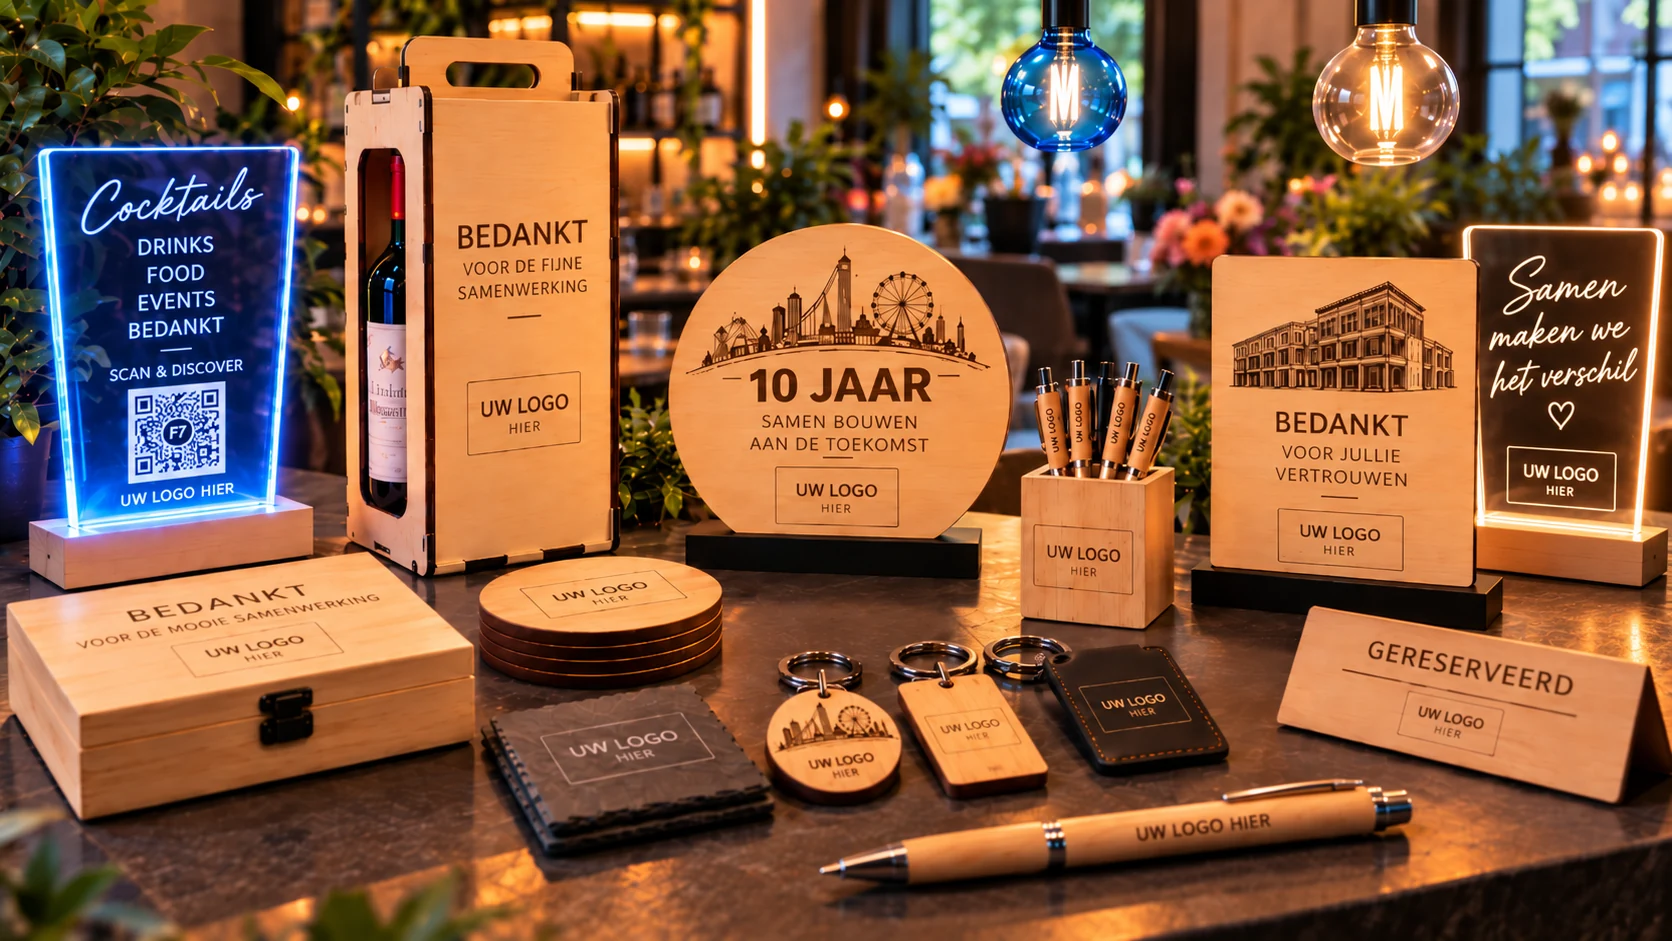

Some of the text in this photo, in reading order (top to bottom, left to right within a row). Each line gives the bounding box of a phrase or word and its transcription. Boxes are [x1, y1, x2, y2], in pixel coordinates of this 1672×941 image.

[80, 167, 264, 235] Cocktails
[457, 220, 588, 249] BEDANKT
[138, 235, 214, 256] DRINKS
[147, 264, 205, 284] FOOD
[463, 256, 582, 276] VOOR DE FIJNE
[458, 279, 588, 300] SAMENWERKING
[1502, 255, 1627, 316] Samen
[138, 290, 216, 312] EVENTS
[128, 316, 224, 340] BEDANKT
[1489, 311, 1631, 351] maken we
[109, 359, 243, 382] SCAN & DISCOVER
[1490, 347, 1639, 399] het verschil
[750, 367, 932, 403] 10 JAAR
[481, 393, 569, 418] UW LOGO
[1075, 402, 1083, 427] LOGO
[1114, 402, 1126, 427] LOGO
[509, 421, 541, 434] HIER
[762, 414, 917, 430] SAMEN BOUWEN
[1045, 408, 1056, 434] LOGO
[1143, 413, 1156, 436] LOGO
[1275, 411, 1408, 437] BEDANKT
[169, 425, 187, 440] F7
[750, 437, 929, 453] AAN DE TOEKOMST
[1282, 445, 1401, 463] VOOR JULLIE
[1275, 467, 1408, 487] VERTROUWEN
[1523, 463, 1599, 482] UW LOGO
[120, 483, 235, 507] UW LOGO HIER
[796, 483, 878, 498] UW LOGO
[1546, 485, 1574, 497] HIER
[821, 503, 851, 514] HIER
[1300, 524, 1381, 542] UW LOGO
[1047, 544, 1121, 563] UW LOGO
[1323, 545, 1355, 556] HIER
[1071, 566, 1097, 577] HIER
[552, 581, 648, 602] UW LOGO
[592, 595, 629, 606] HIER
[126, 584, 309, 623] BEDANKT
[76, 594, 380, 649] VOOR DE MOOIE SAMENWERKING
[204, 635, 304, 658] UW LOGO
[244, 651, 283, 663] HIER
[1368, 640, 1574, 696] GERESERVEERD
[1101, 693, 1166, 710] UW LOGO
[1128, 707, 1156, 718] HIER
[1418, 706, 1485, 730] UW LOGO
[940, 719, 1000, 734] UW LOGO
[966, 732, 989, 740] HIER
[1434, 725, 1462, 740] HIER
[569, 730, 678, 758] UW LOGO
[615, 749, 655, 763] HIER
[808, 752, 874, 770] UW LOGO
[832, 768, 859, 779] HIER
[1136, 813, 1271, 841] UW LOGO HIER
